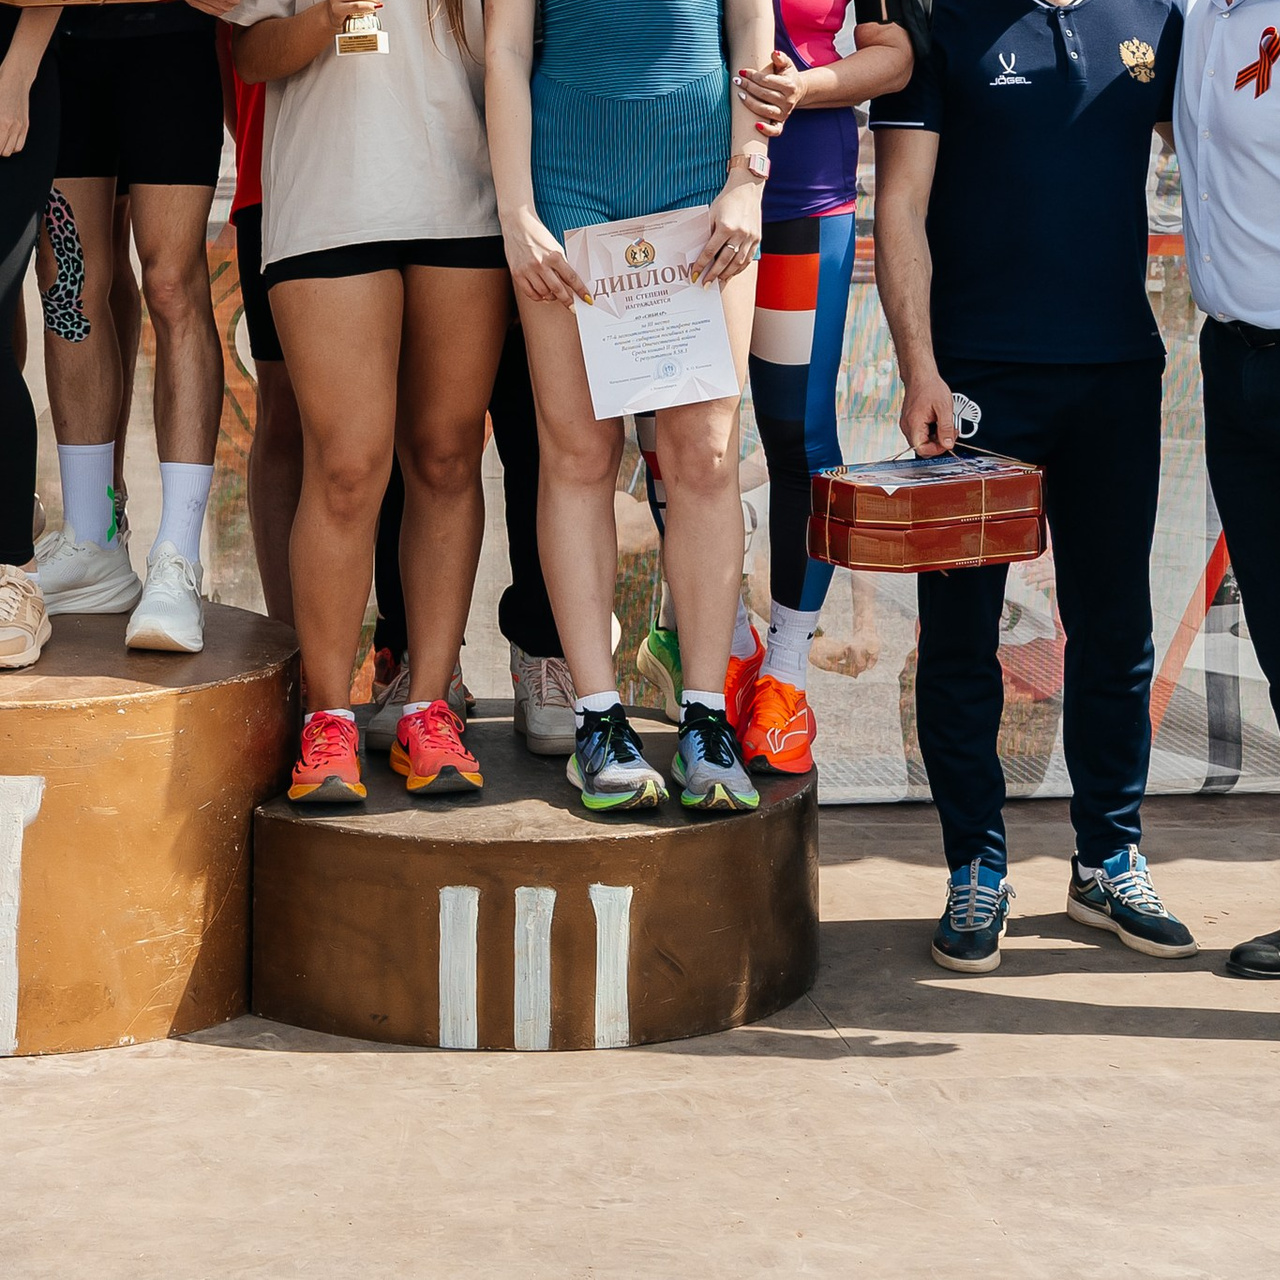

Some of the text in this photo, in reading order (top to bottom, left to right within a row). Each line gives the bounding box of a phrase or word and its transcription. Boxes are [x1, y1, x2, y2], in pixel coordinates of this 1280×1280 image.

[989, 75, 1032, 86] JÖGEL
[593, 263, 695, 300] ДИПЛОМ
[635, 289, 668, 300] СТЕПЕНИ
[624, 298, 671, 310] НАГРАЖДАЕТСЯ
[438, 884, 634, 1050] III
